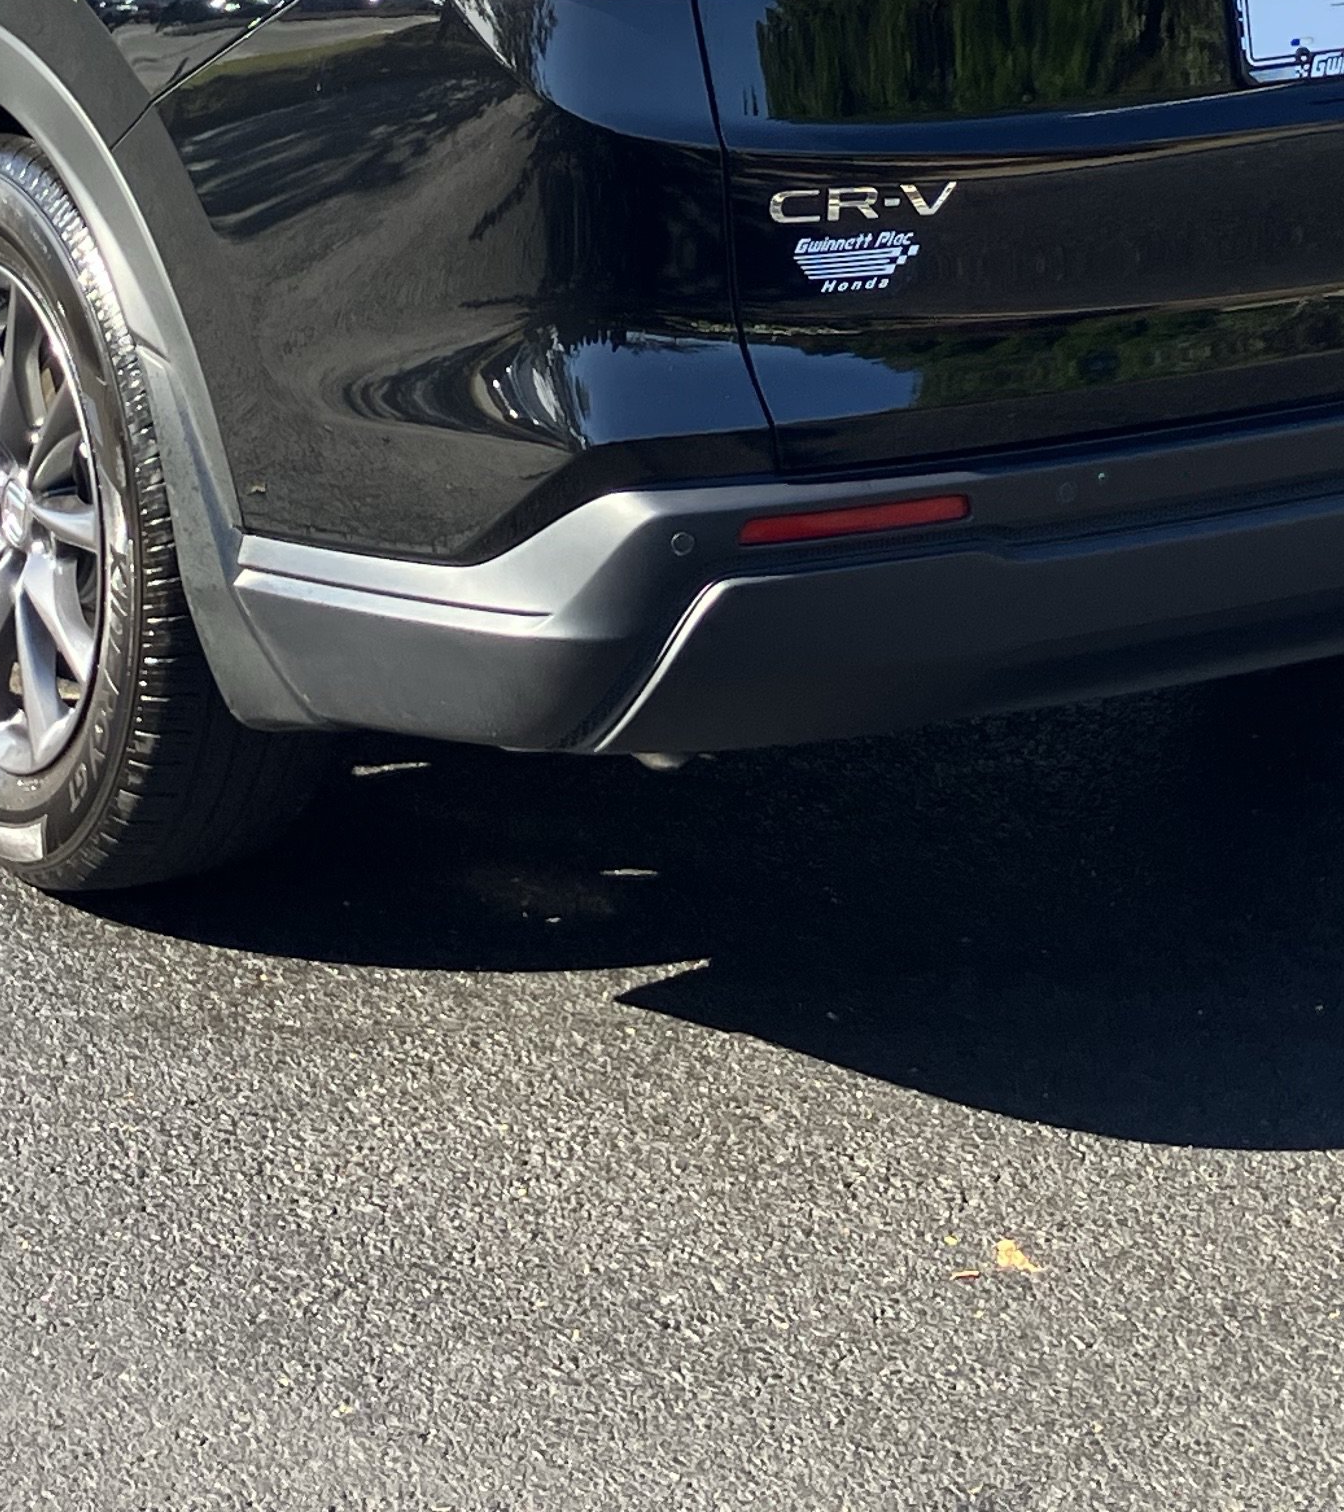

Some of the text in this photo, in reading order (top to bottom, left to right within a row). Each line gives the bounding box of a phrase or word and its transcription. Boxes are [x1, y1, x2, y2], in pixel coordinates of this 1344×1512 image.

[769, 181, 957, 223] CR-V
[794, 233, 873, 254] Gwinnett
[820, 277, 890, 293] Honda
